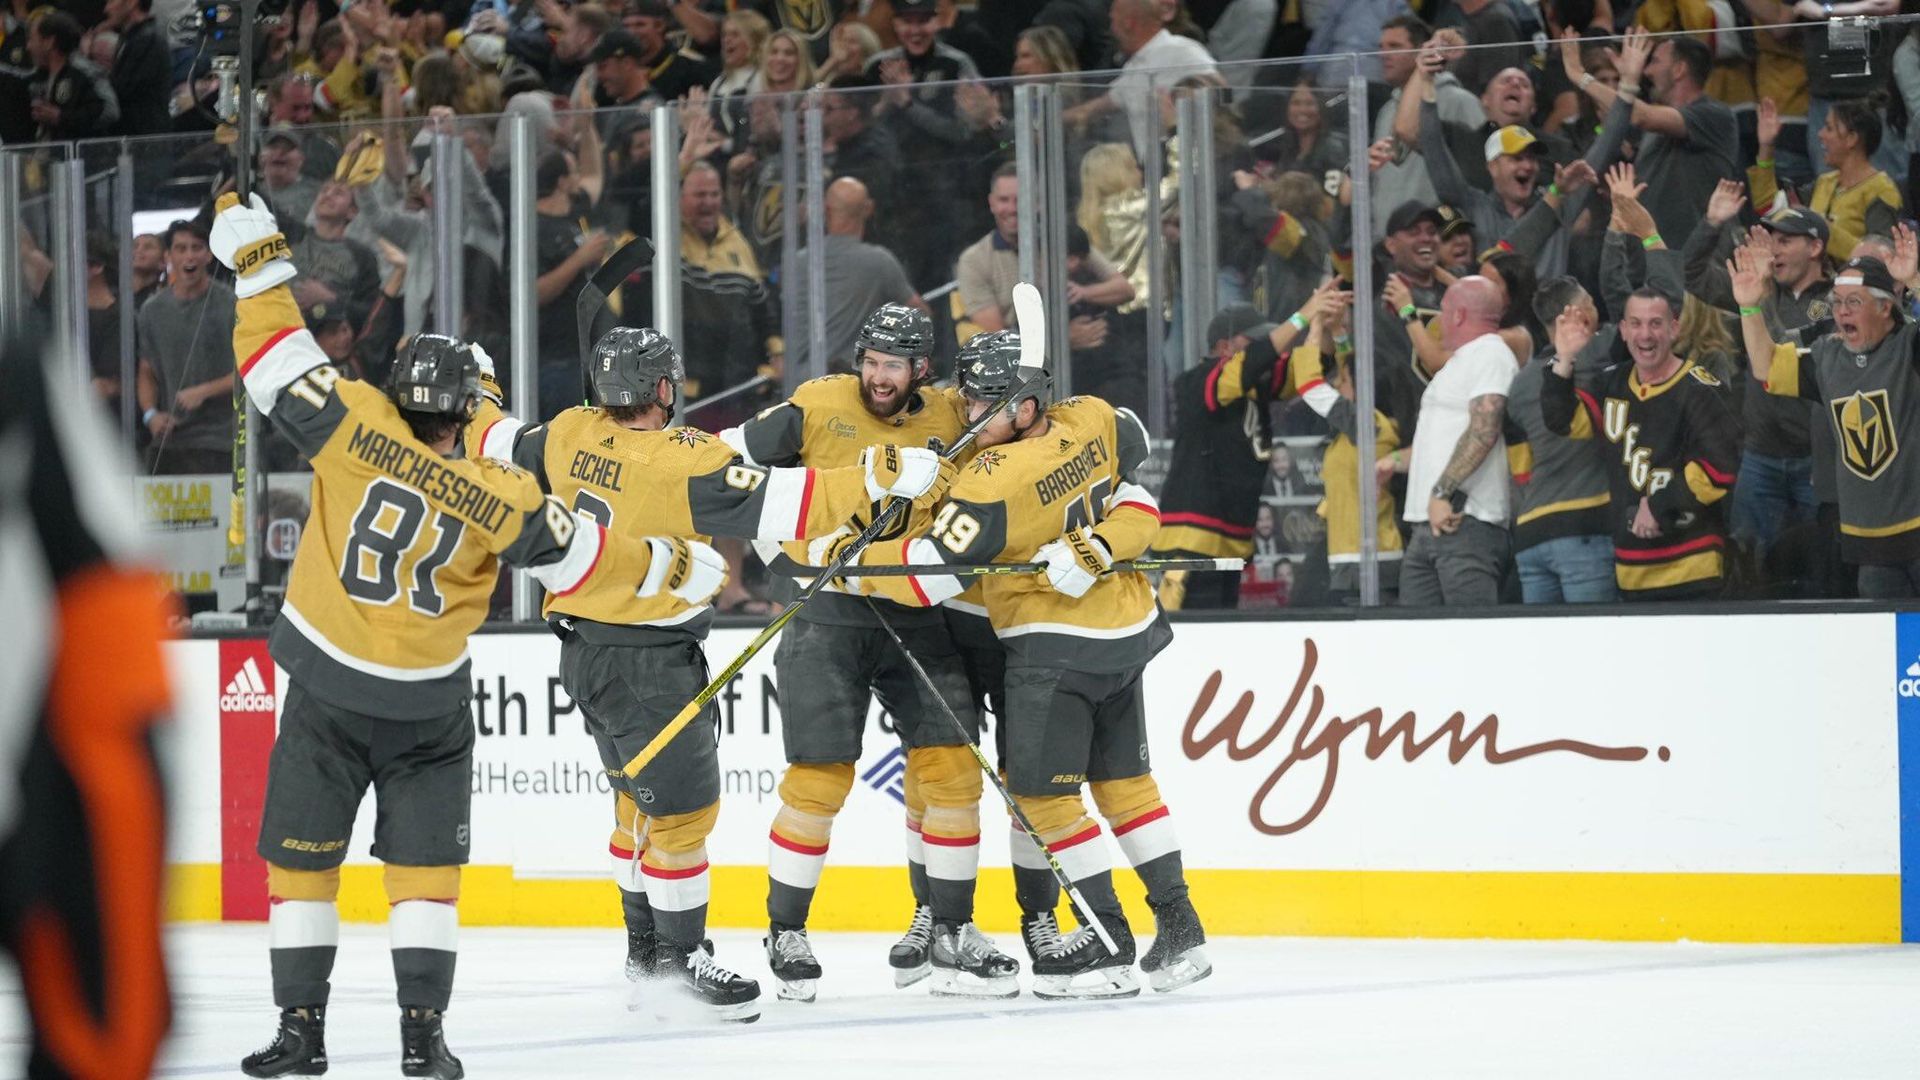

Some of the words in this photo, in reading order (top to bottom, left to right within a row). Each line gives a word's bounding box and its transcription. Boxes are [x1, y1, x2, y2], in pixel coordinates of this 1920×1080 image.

[236, 238, 288, 274] AUER
[603, 357, 611, 371] 9
[413, 386, 429, 403] 81
[347, 422, 515, 535] MARCHESSAULT
[569, 450, 623, 493] EICHEL
[339, 476, 467, 618] 81
[933, 502, 980, 554] 49
[220, 693, 275, 712] adidas
